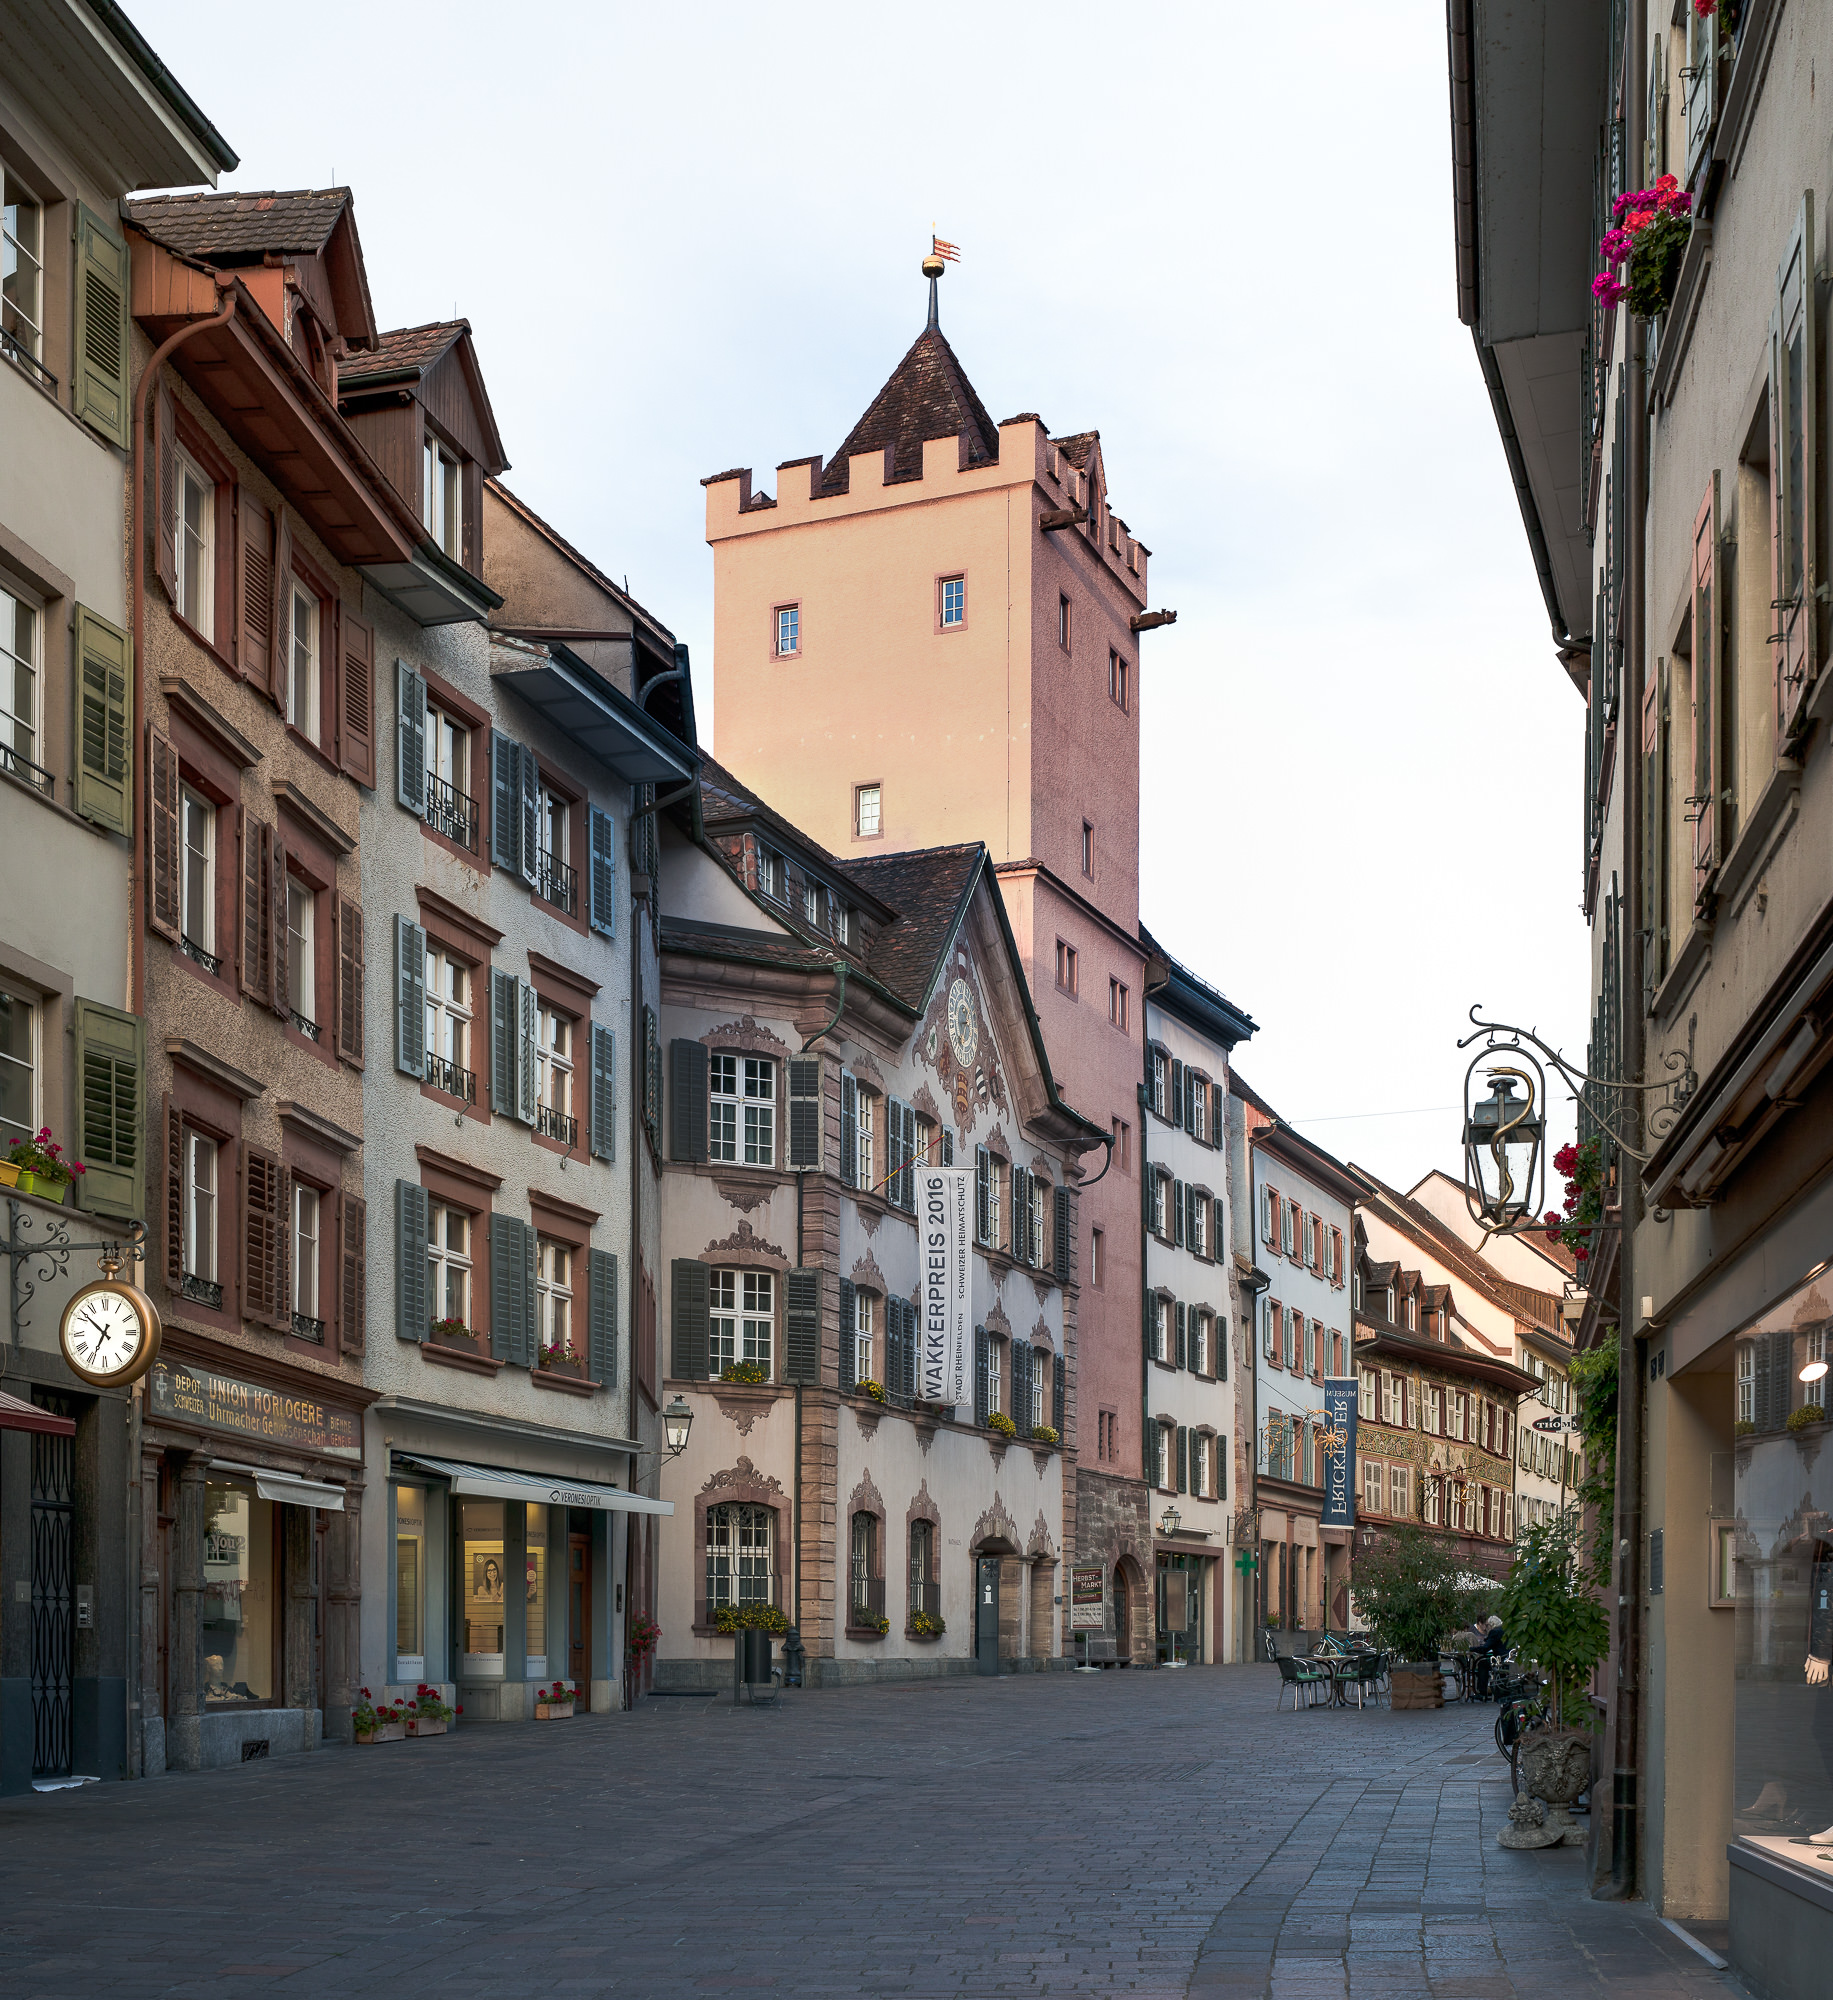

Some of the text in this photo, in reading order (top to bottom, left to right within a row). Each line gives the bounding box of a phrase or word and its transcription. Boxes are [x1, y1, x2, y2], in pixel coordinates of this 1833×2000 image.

[925, 1177, 945, 1400] WAKKERPREIS 2016
[955, 1176, 966, 1400] STADT RHEINFELDEN SCHWEIZER HEIMATSCHUTZ
[175, 1374, 201, 1395] DEPOT
[208, 1377, 248, 1409] UNION
[174, 1393, 204, 1414] SCHWEIZER
[208, 1401, 260, 1432] Uhrmacher
[1080, 1580, 1102, 1589] MARKT
